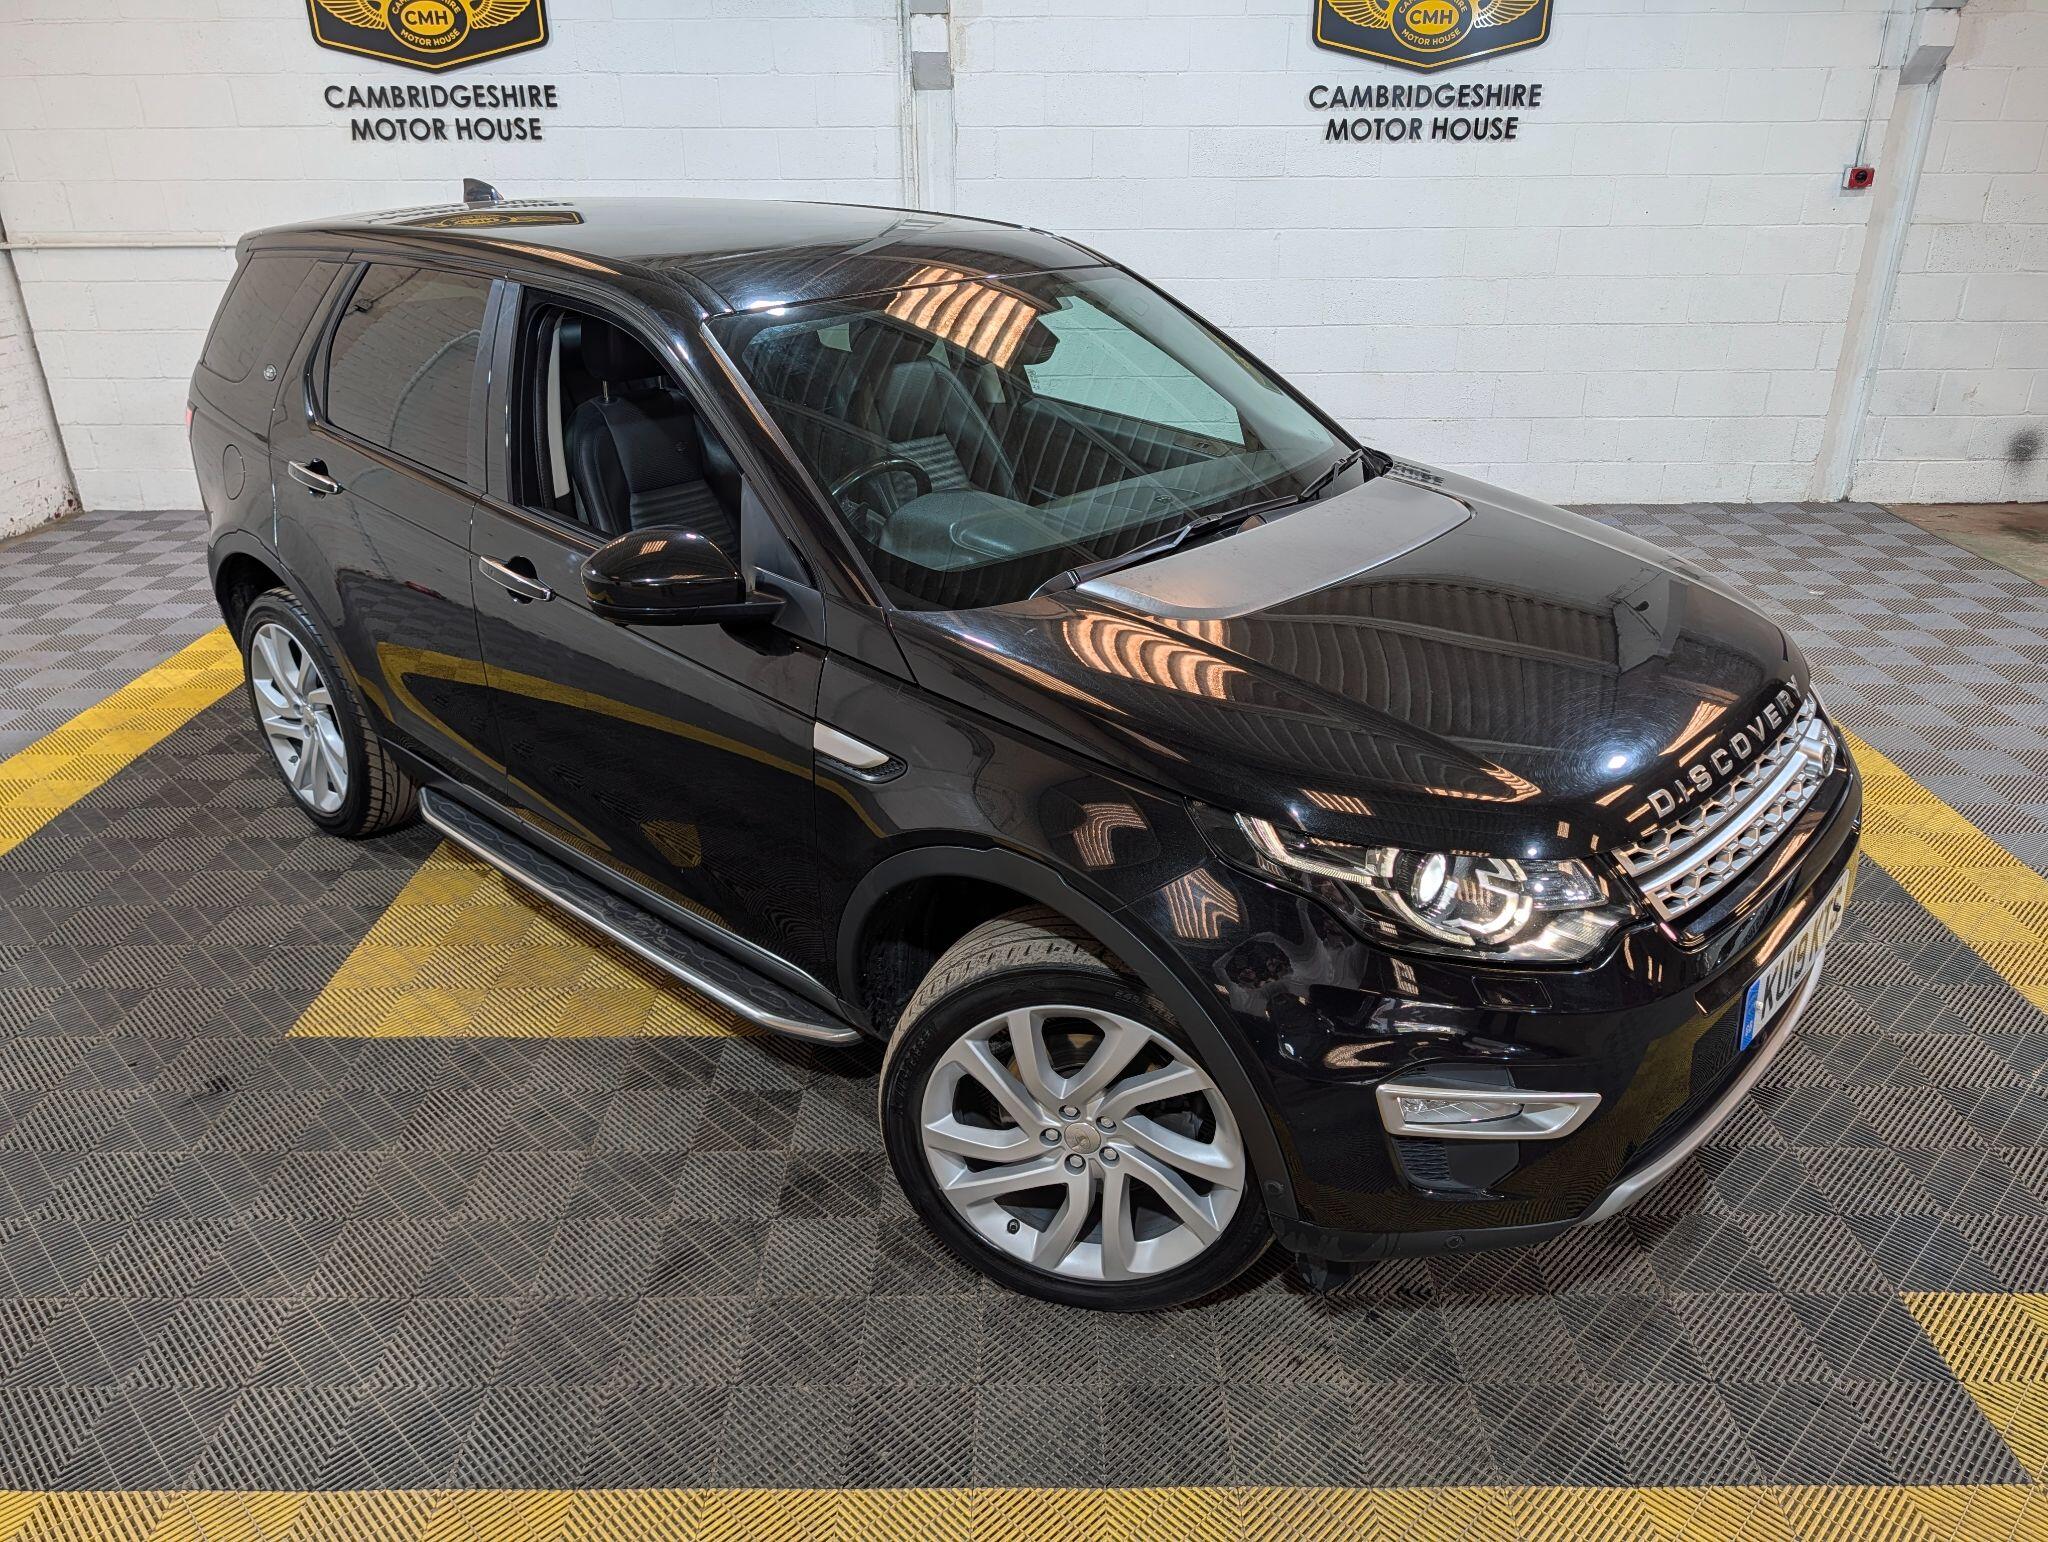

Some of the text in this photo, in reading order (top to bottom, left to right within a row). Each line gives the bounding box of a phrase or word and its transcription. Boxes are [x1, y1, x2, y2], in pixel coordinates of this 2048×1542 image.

[404, 10, 449, 26] CMH
[1409, 9, 1453, 25] CMH
[400, 28, 461, 46] MOTOR HOUSE
[1401, 27, 1461, 46] MOTOR HOUSE
[324, 84, 558, 109] CAMBRIDGESHIRE
[1309, 83, 1542, 109] CAMBRIDGESHIRE
[351, 116, 543, 141] MOTOR HOUSE
[1325, 116, 1518, 141] MOTOR HOUSE
[1647, 674, 1802, 819] DISCOVERY
